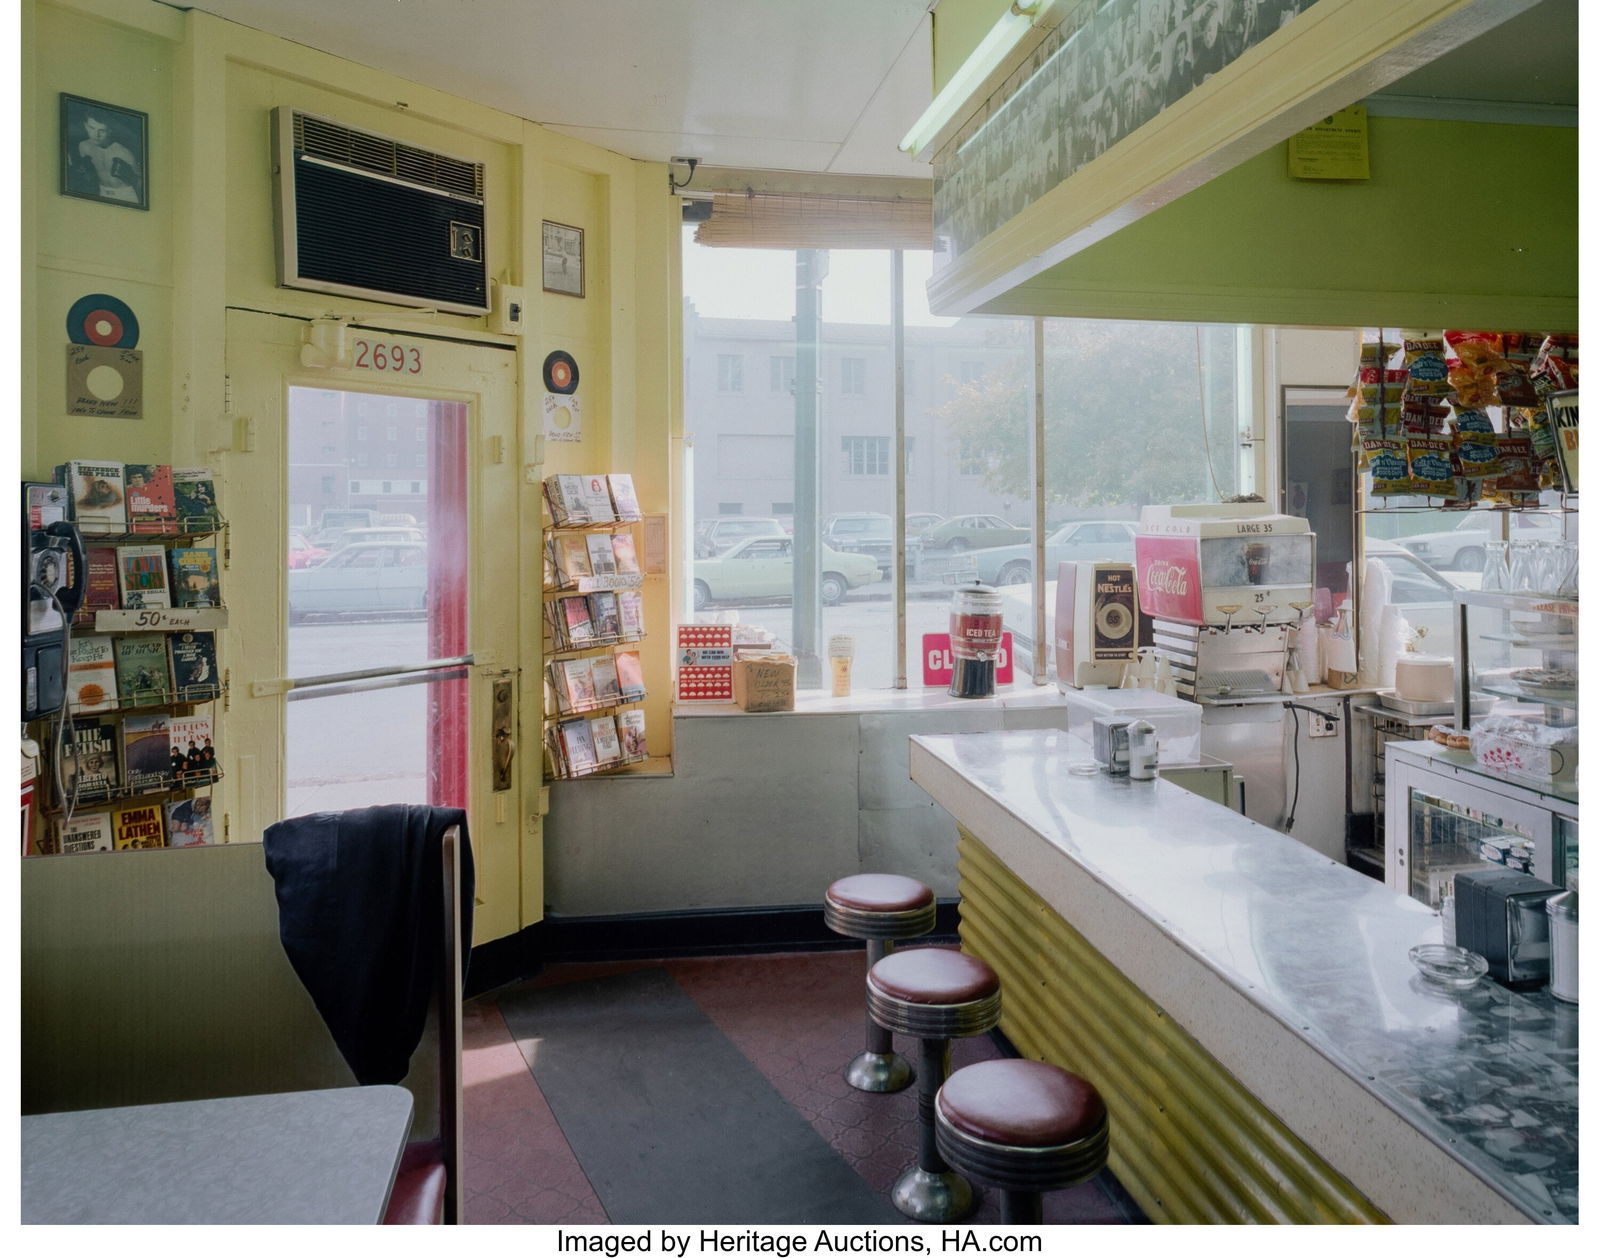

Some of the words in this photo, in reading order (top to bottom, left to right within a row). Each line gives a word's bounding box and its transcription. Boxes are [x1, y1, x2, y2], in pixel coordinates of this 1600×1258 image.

[356, 341, 421, 374] 2693
[130, 496, 151, 504] Little
[131, 504, 168, 513] murders
[1236, 524, 1260, 534] LARGE
[1264, 524, 1273, 532] 35
[1146, 564, 1188, 596] Coca-Cola
[966, 628, 982, 637] ICED
[984, 629, 996, 637] TEA
[928, 648, 1008, 670] CLD
[756, 668, 780, 679] NEW
[75, 727, 102, 743] THE
[121, 808, 156, 826] EMMA
[63, 829, 101, 844] UNANSWERED
[118, 822, 160, 841] LATHEN
